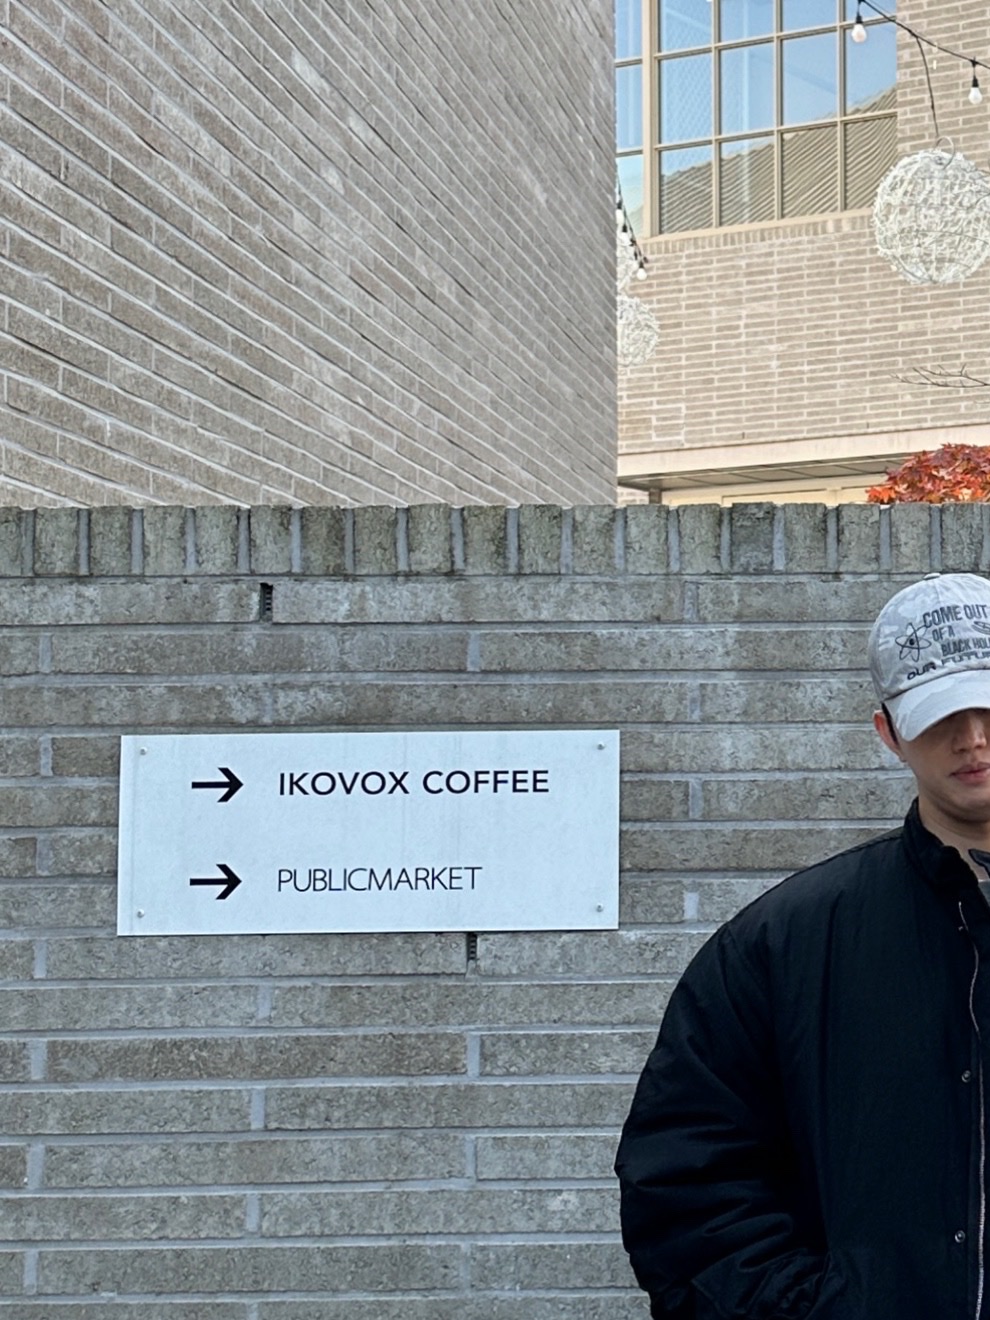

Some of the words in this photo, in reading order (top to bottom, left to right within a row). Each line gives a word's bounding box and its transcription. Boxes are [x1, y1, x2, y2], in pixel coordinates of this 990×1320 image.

[923, 605, 962, 629] COME
[963, 604, 988, 620] OUT
[932, 627, 945, 642] OF
[948, 625, 956, 638] A
[941, 638, 972, 657] BLACK
[279, 771, 410, 796] IKOVOX
[422, 770, 550, 795] COFFEE
[277, 867, 483, 893] PUBLICMARKET
